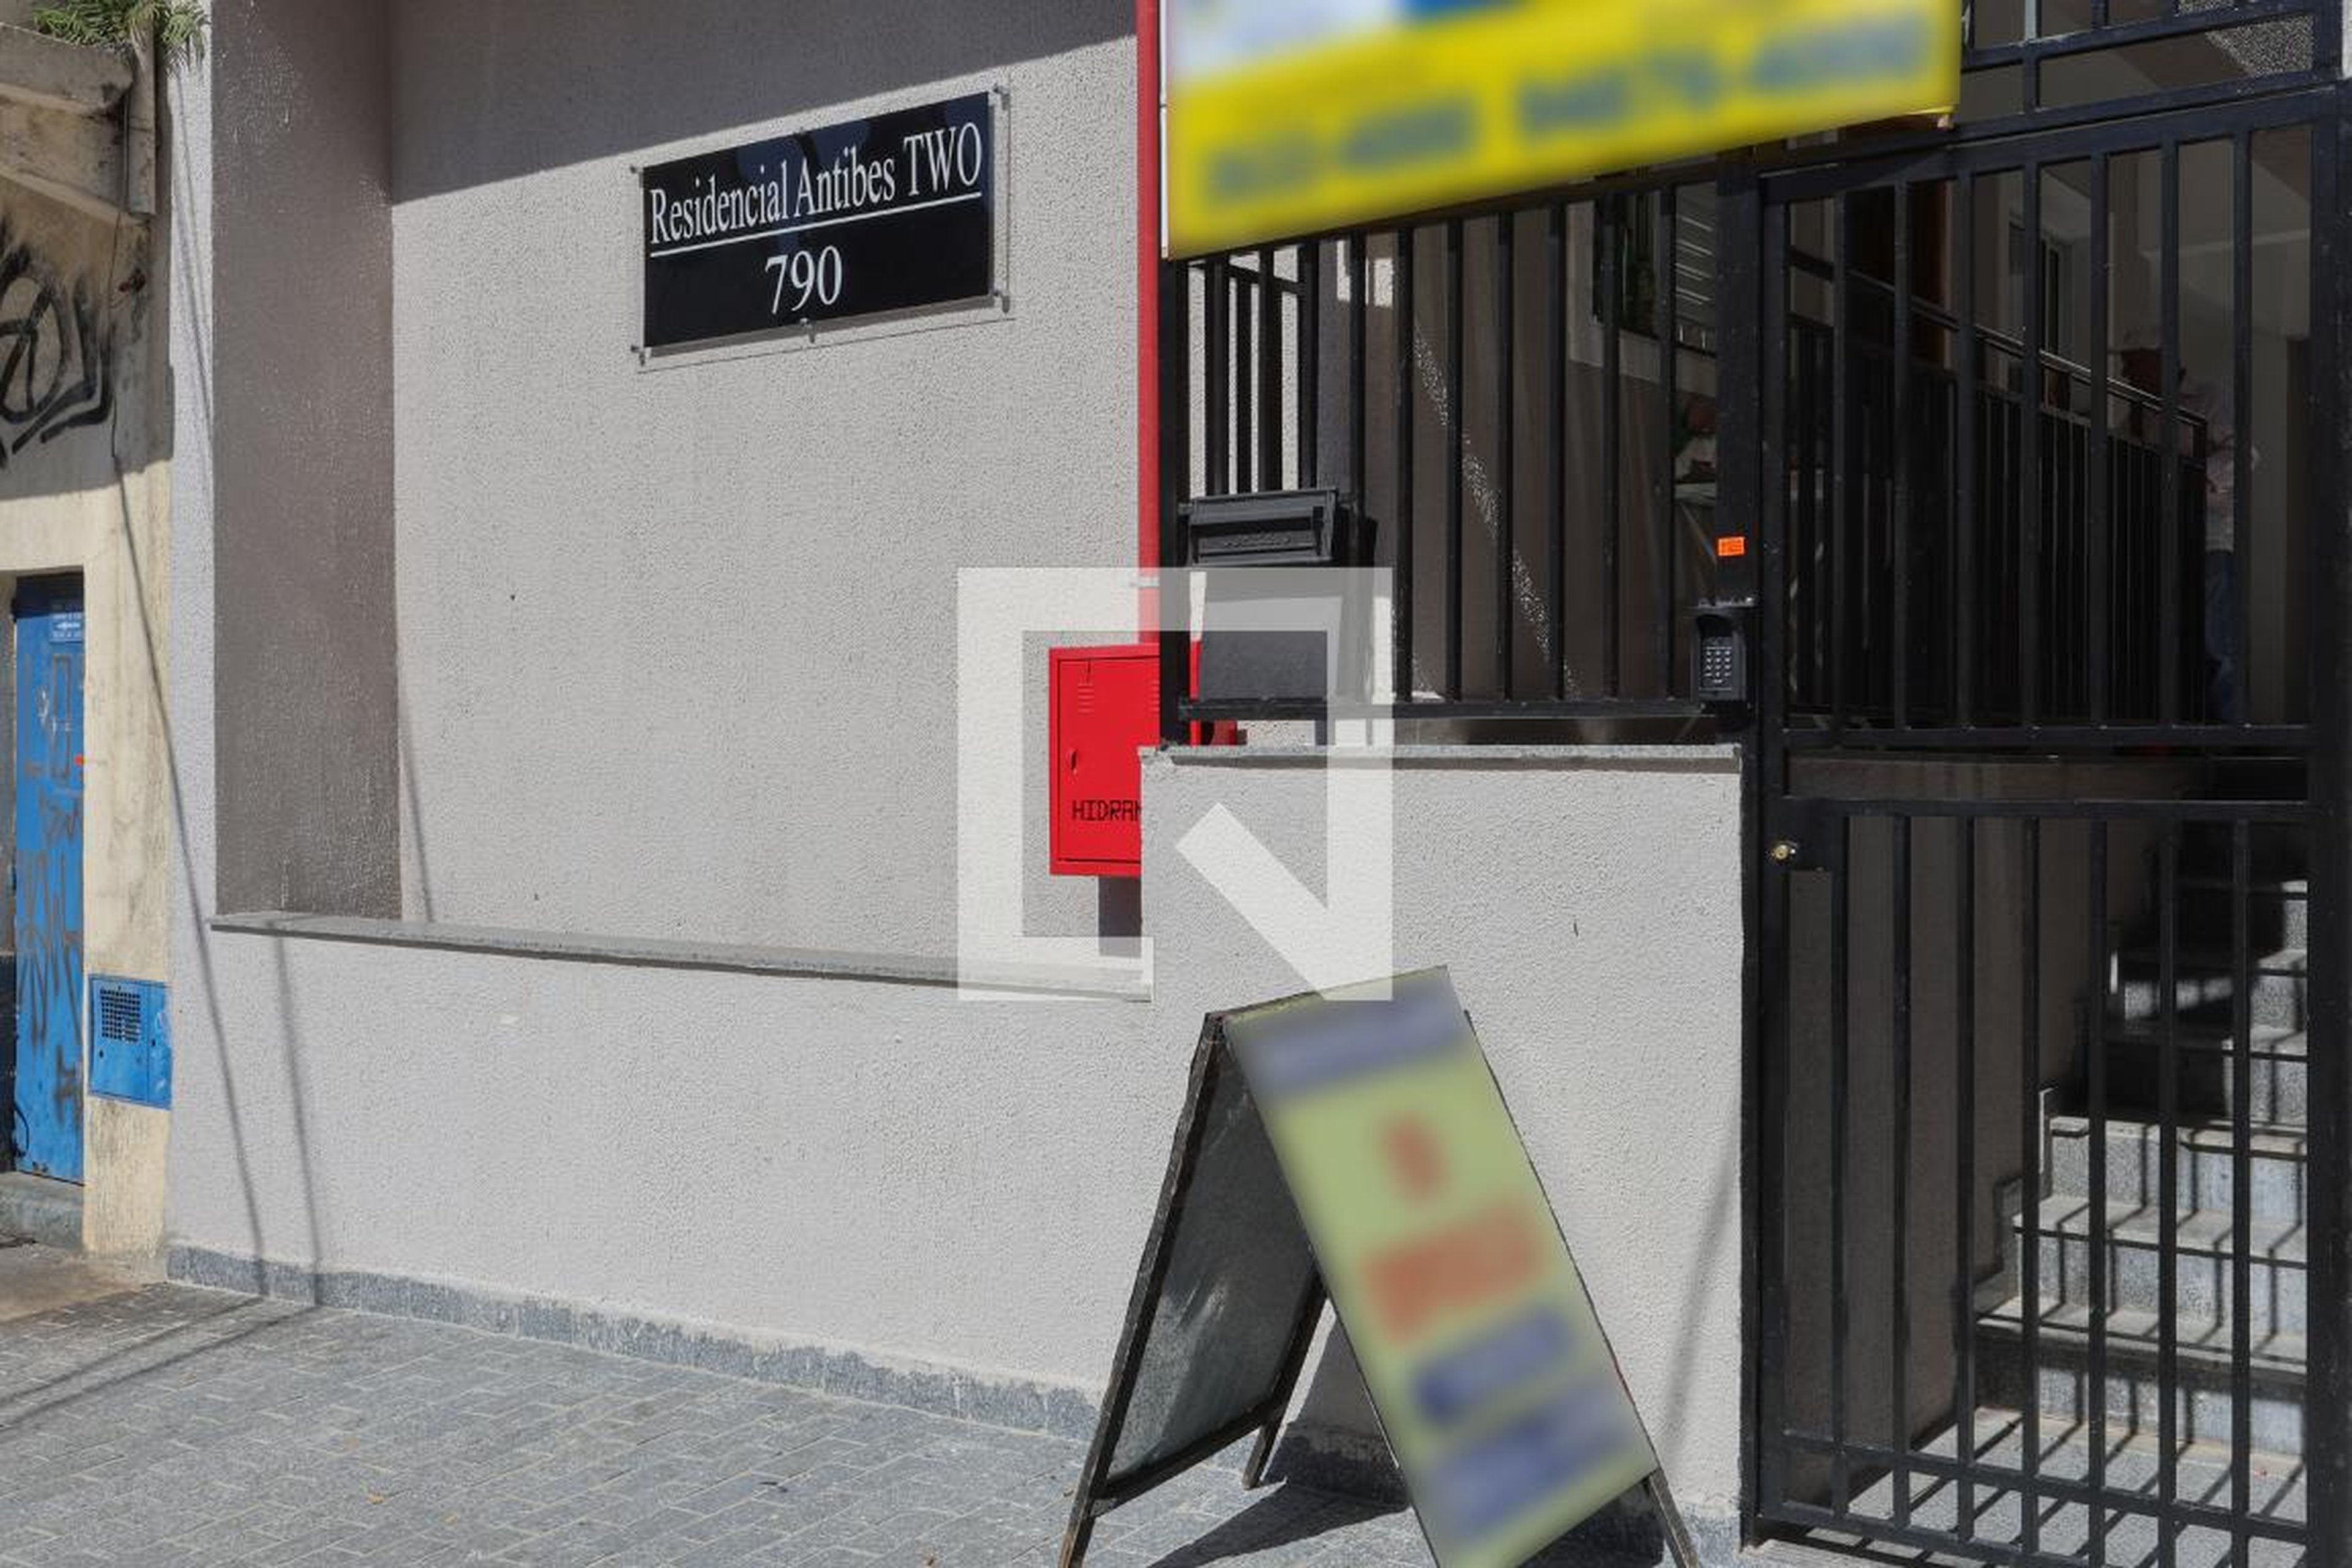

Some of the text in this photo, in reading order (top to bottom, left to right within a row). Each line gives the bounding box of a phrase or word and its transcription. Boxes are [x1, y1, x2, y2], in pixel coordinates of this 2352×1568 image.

[650, 122, 981, 244] Residencial Antibes TWO
[764, 246, 842, 314] 790
